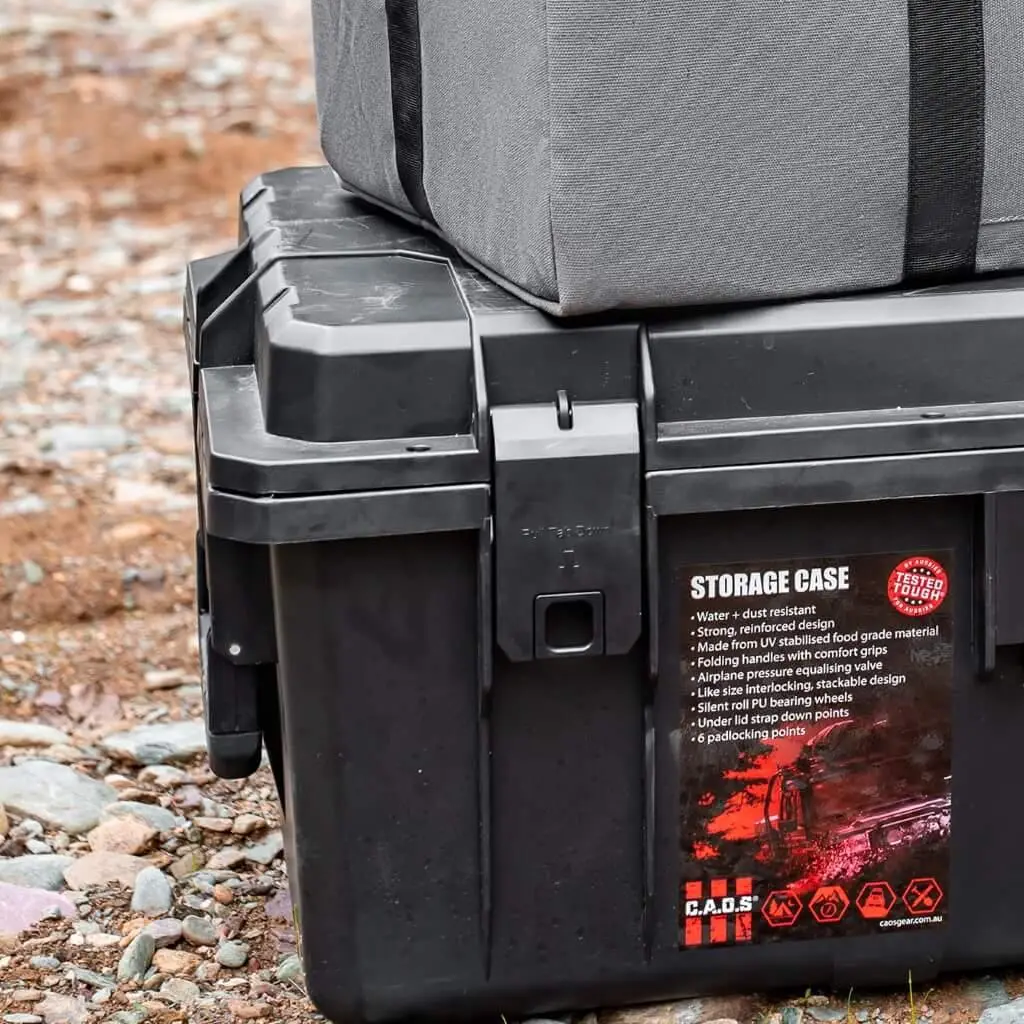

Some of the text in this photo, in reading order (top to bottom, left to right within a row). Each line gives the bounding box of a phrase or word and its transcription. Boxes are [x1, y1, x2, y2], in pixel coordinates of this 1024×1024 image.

[690, 566, 850, 599] STORAGE CASE
[893, 582, 941, 601] TOUGH
[896, 572, 944, 591] TESTED
[697, 605, 816, 622] Water + dust resistant
[697, 619, 835, 638] Strong, reinforced design
[697, 626, 939, 653] Made from UV stabilised food grade material
[697, 645, 888, 669] Folding handles with comfort grips
[697, 660, 883, 684] Airplane pressure equalising valve
[697, 674, 906, 698] Like size interlocking, stackable design
[697, 691, 853, 713] Silent roll PU bearing wheels
[697, 707, 850, 728] Under lid strap down points
[697, 726, 806, 744] 6 padlocking points
[879, 916, 943, 927] caosgear.com.au
